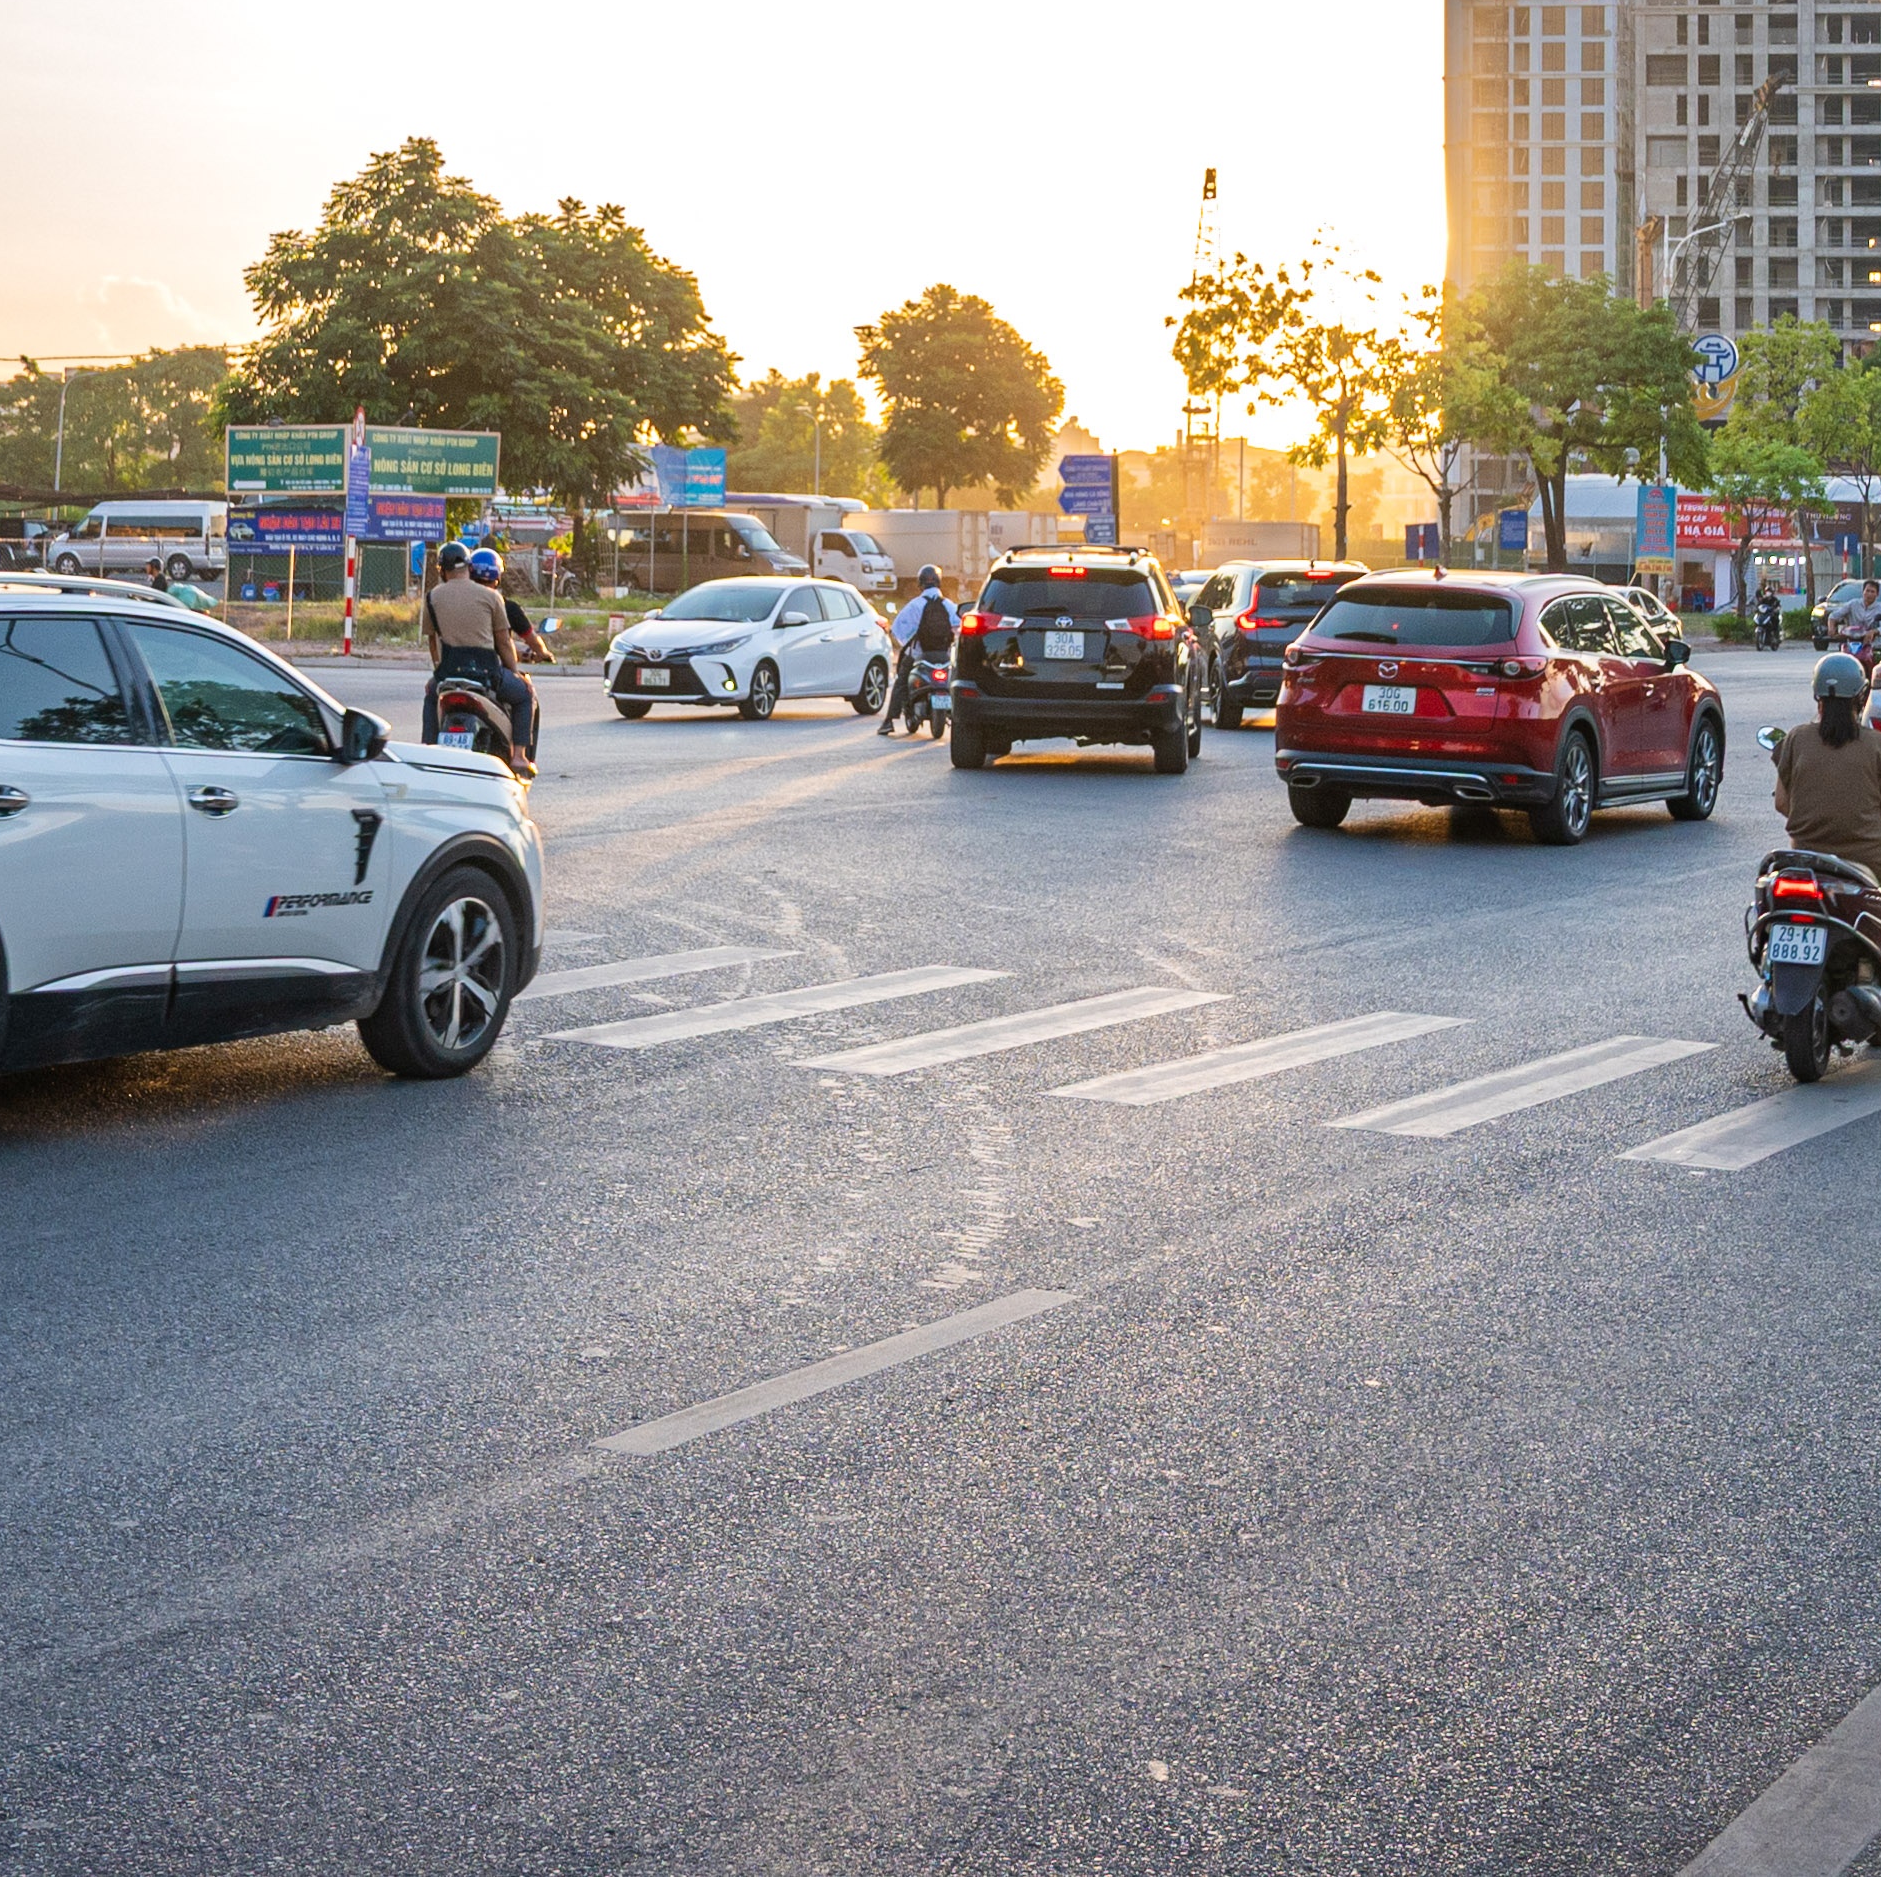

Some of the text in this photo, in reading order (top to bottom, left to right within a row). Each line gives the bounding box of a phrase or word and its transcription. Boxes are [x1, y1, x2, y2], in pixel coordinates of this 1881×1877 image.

[374, 456, 398, 473] NÔNG
[401, 456, 418, 473] SẢN
[420, 460, 433, 474] CƠ
[448, 463, 471, 476] LONG
[473, 460, 494, 477] BIÊN
[1704, 524, 1726, 537] GIÁ
[1054, 632, 1075, 644] 30A
[1046, 644, 1083, 657] 325.05
[1378, 686, 1401, 700] 30G
[1368, 698, 1409, 713] 616.00
[277, 890, 374, 909] PERFORMANCE
[1779, 926, 1818, 944] 29-K1
[1772, 943, 1821, 962] 888.92
